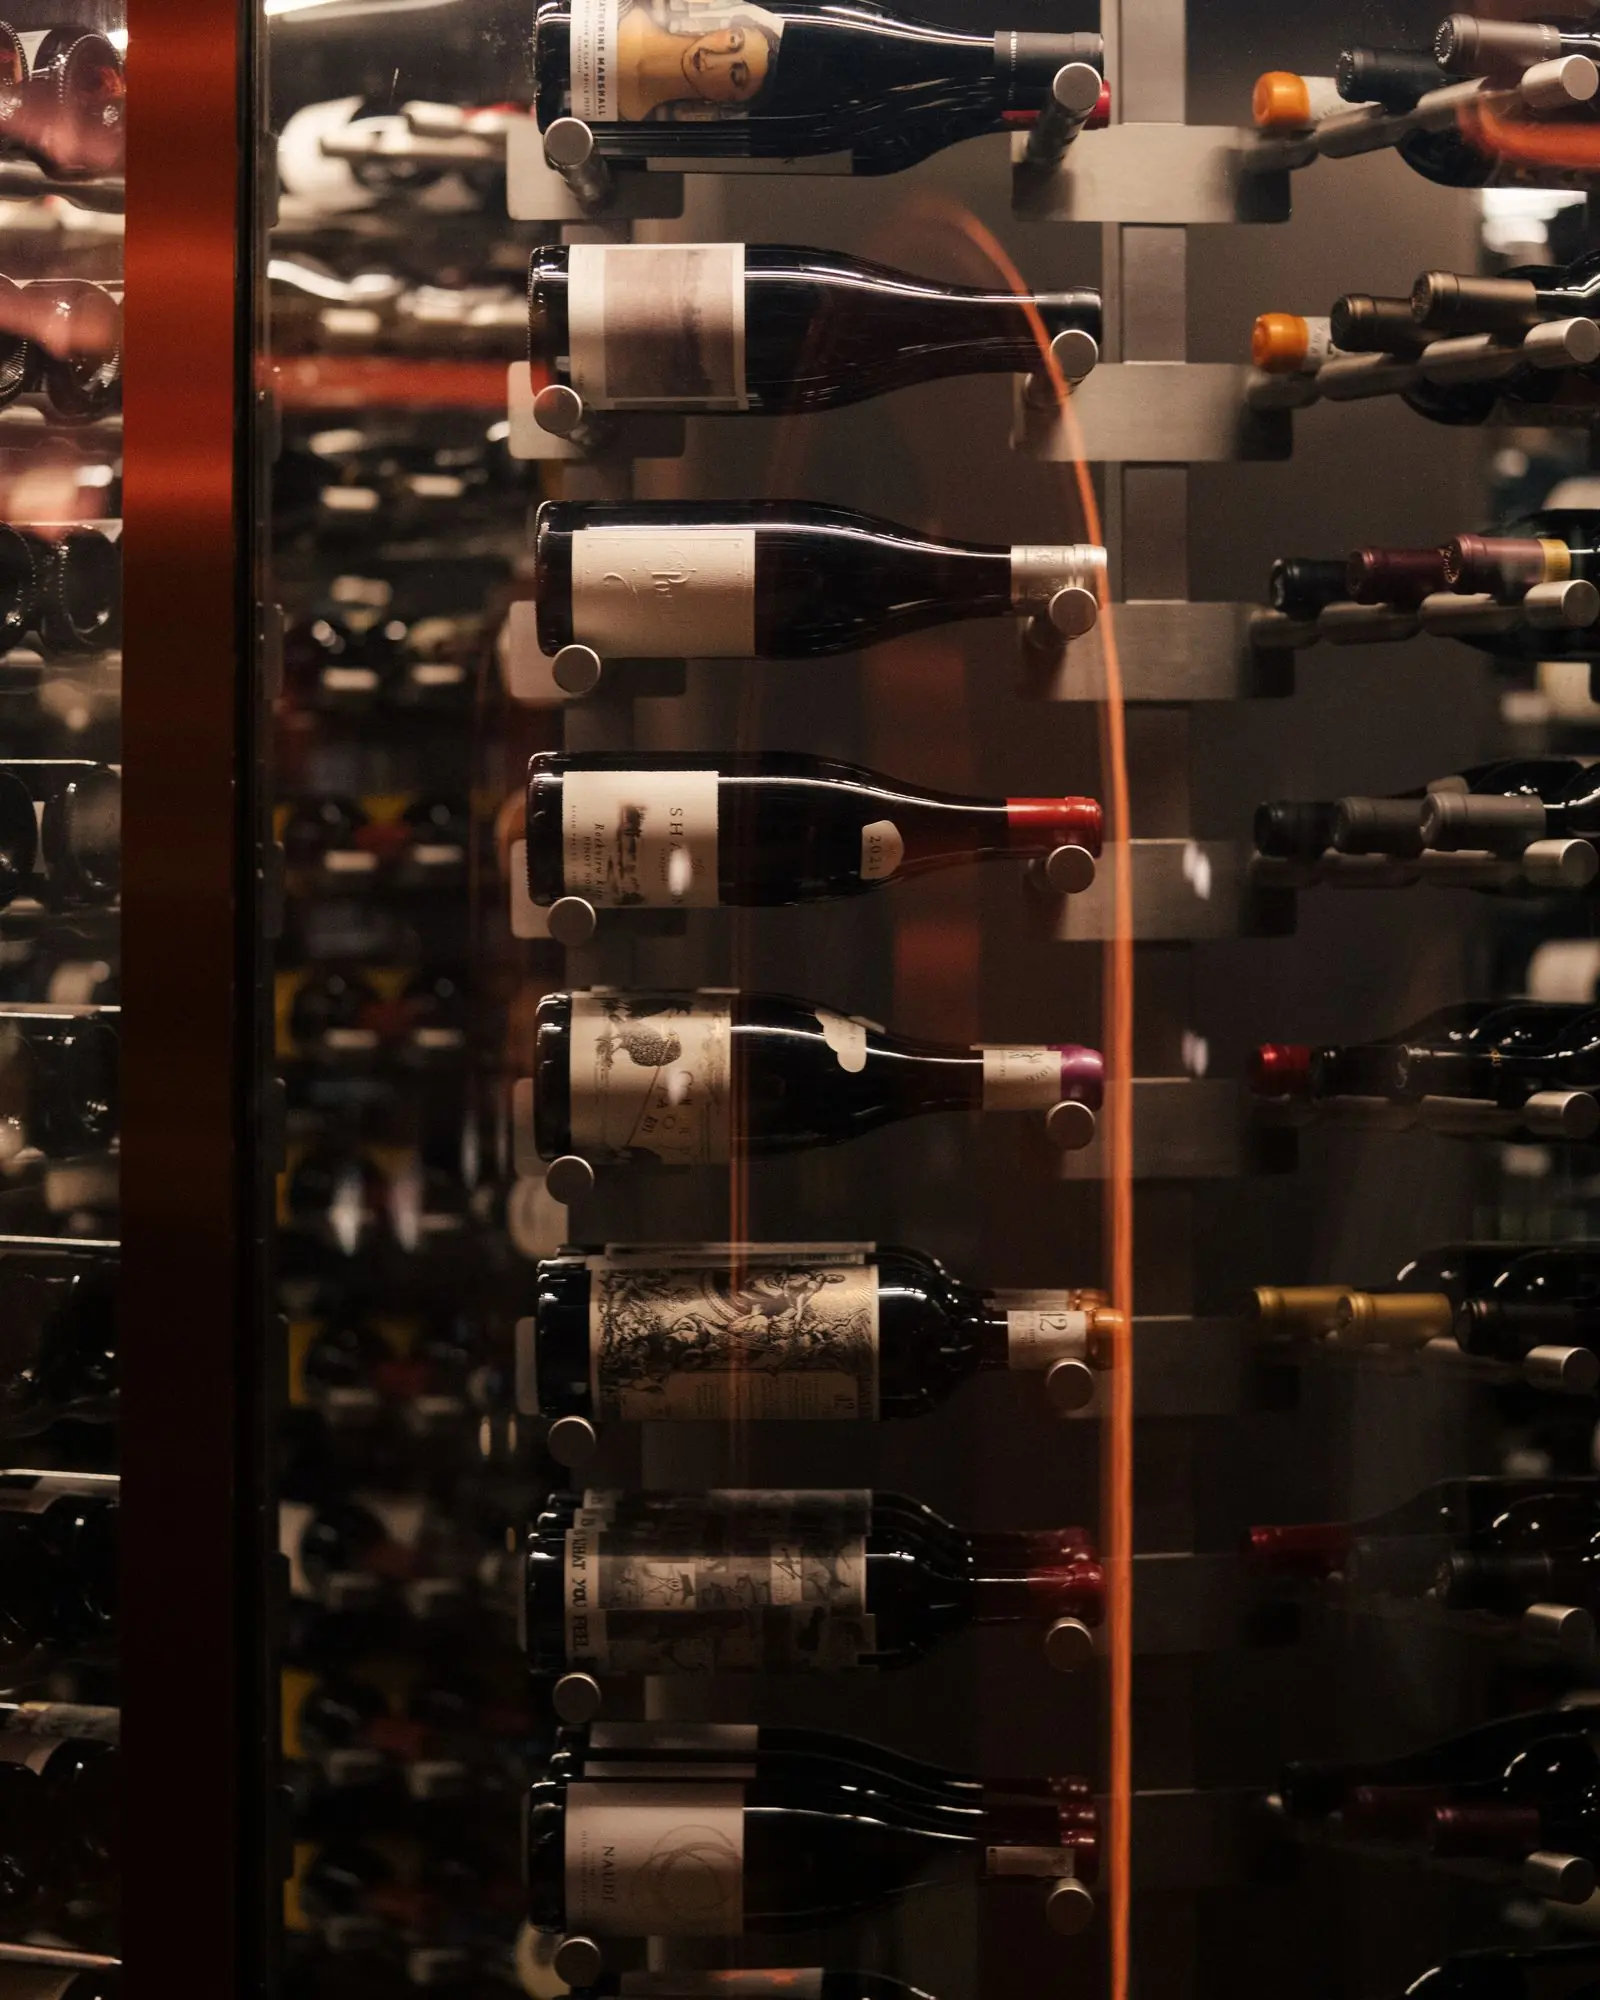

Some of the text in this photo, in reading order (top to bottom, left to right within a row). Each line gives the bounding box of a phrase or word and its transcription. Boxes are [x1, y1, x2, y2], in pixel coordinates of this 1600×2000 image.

[583, 52, 591, 70] CLAY
[597, 0, 605, 116] ATHERINE MARSHALL
[583, 836, 591, 868] PINOT
[669, 807, 684, 906] SHAN
[869, 835, 881, 871] 2021
[573, 1538, 588, 1570] WHAT
[573, 1578, 588, 1608] YOU
